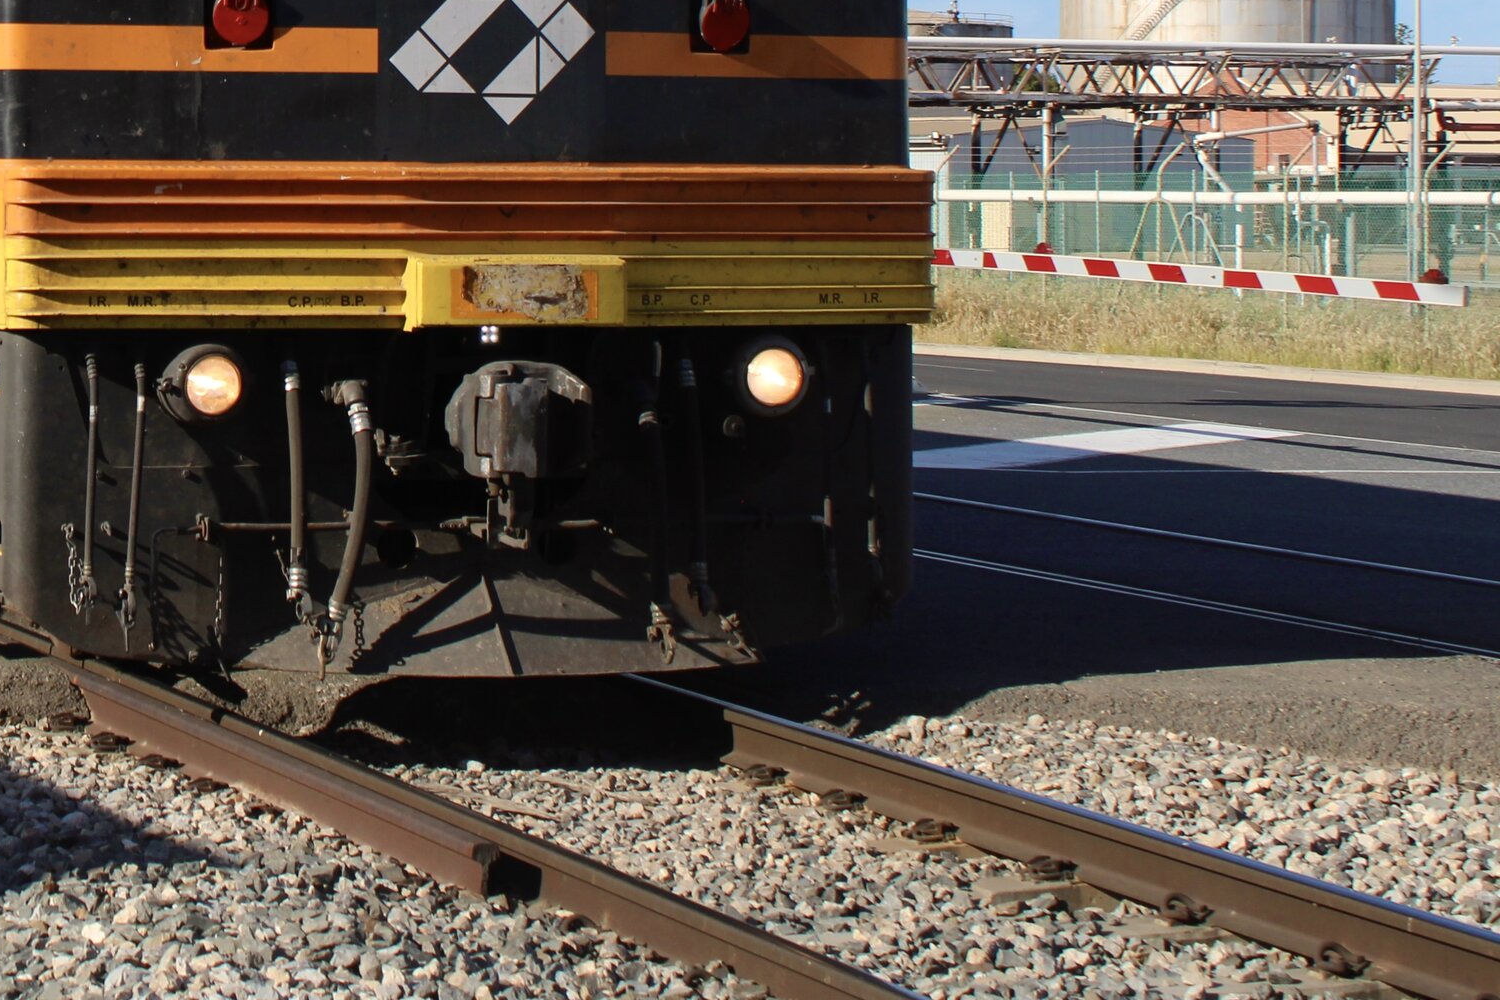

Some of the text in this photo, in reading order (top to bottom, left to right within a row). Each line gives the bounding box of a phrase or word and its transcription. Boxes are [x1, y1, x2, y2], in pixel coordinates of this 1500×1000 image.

[88, 295, 110, 307] I.R.
[127, 295, 157, 307] M.R.
[288, 296, 313, 308] C.P.
[341, 295, 366, 306] B.P.
[641, 294, 712, 306] B.P. C.P.
[819, 293, 882, 304] M.R. I.R.
